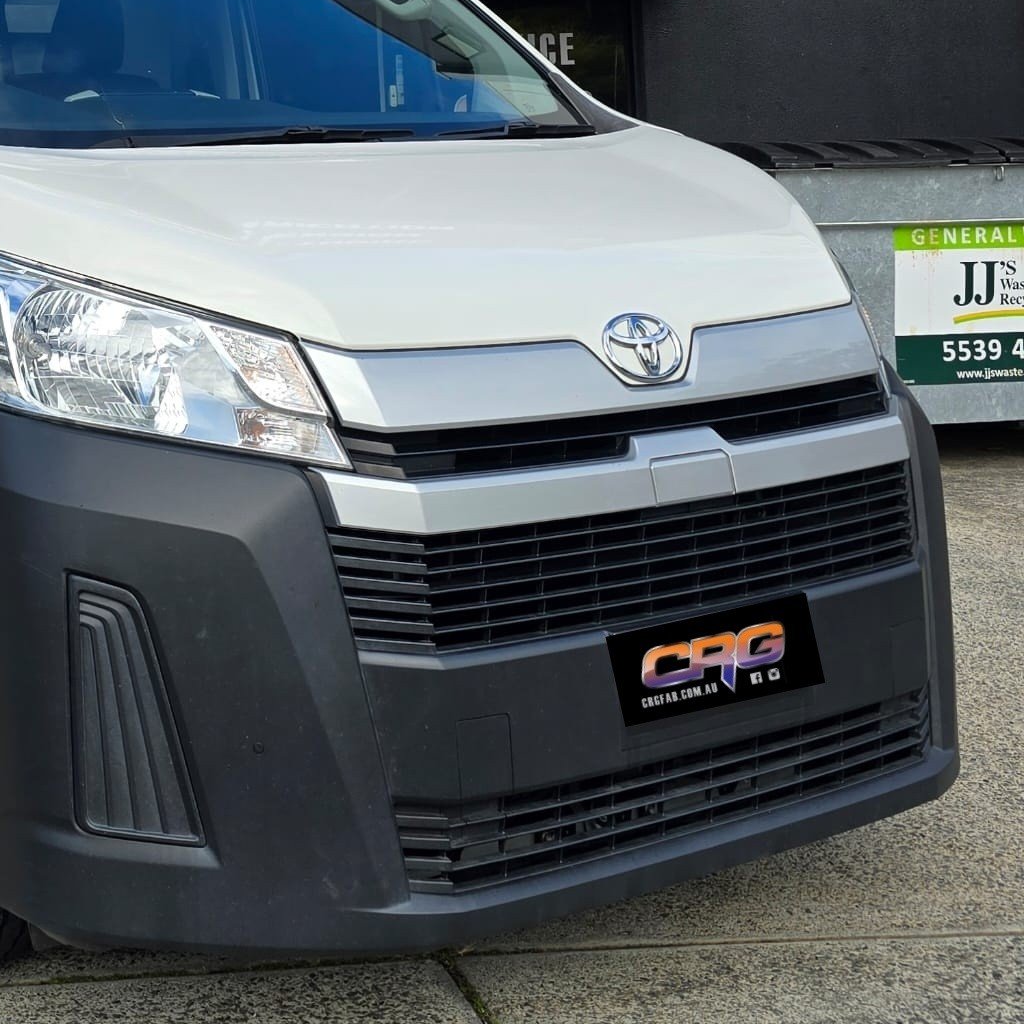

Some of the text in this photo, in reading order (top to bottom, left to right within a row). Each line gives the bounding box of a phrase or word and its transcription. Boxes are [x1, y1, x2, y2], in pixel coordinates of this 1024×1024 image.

[911, 226, 1017, 246] GENERAL
[942, 339, 1002, 362] 5539
[641, 621, 786, 694] CRG
[641, 682, 719, 709] CRGFAB.COM.AU
